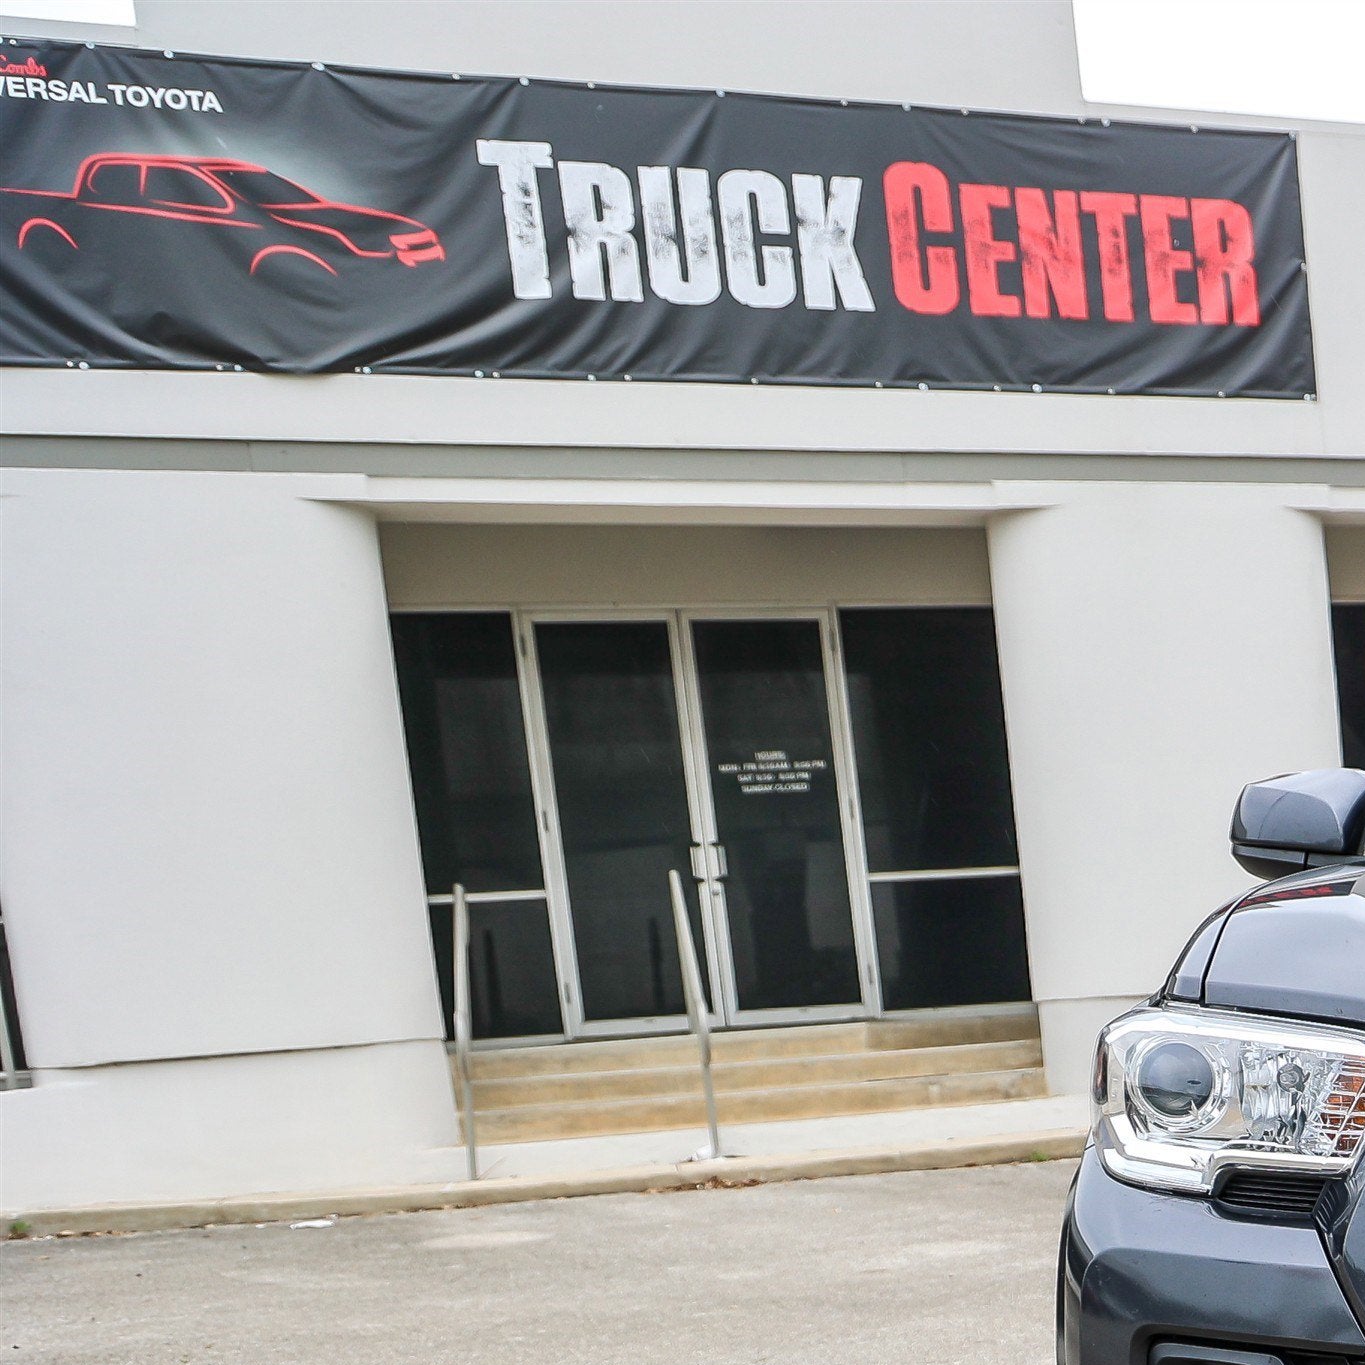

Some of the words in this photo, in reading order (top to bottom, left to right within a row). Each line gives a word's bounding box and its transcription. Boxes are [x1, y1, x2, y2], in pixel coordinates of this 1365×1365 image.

[107, 84, 224, 114] TOYOTA
[476, 139, 876, 312] TRUCK
[882, 161, 1260, 327] CENTER
